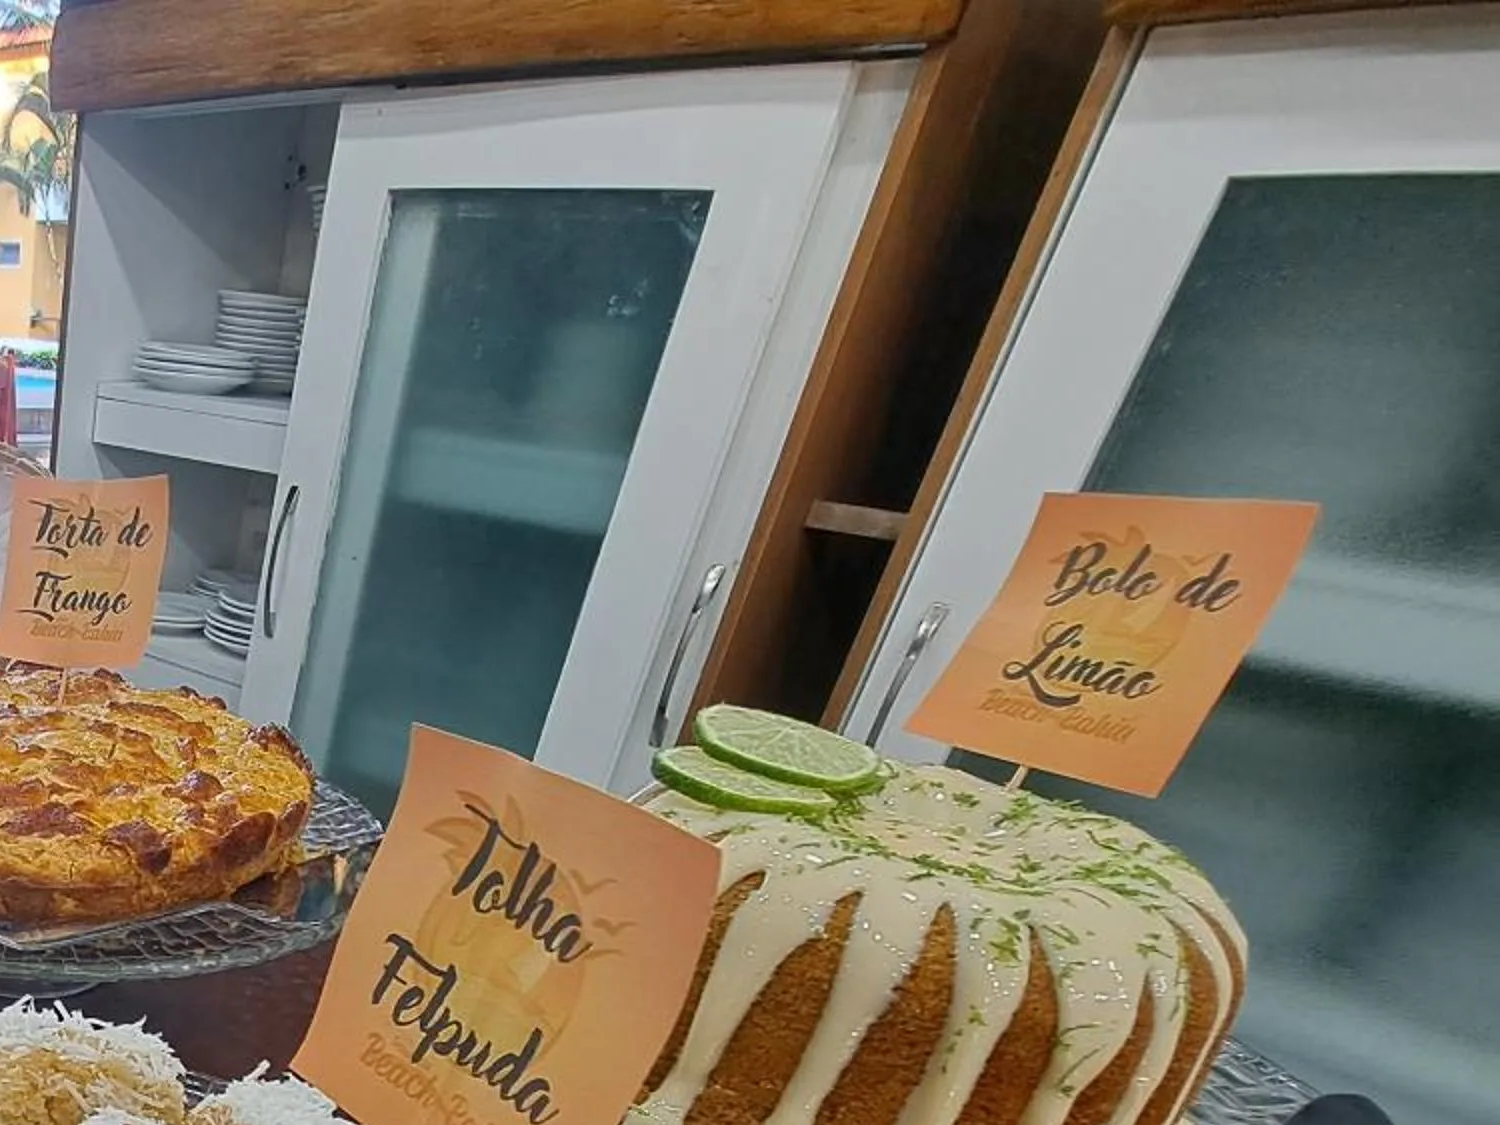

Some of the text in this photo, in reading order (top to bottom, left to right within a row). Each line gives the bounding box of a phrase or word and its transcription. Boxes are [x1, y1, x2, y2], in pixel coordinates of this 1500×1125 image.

[28, 499, 153, 558] Torta de
[15, 571, 134, 626] Frango
[1044, 541, 1241, 613] Bolo de
[1002, 621, 1162, 706] Limão
[451, 803, 594, 962] Tolha
[370, 932, 560, 1125] Felpuda
